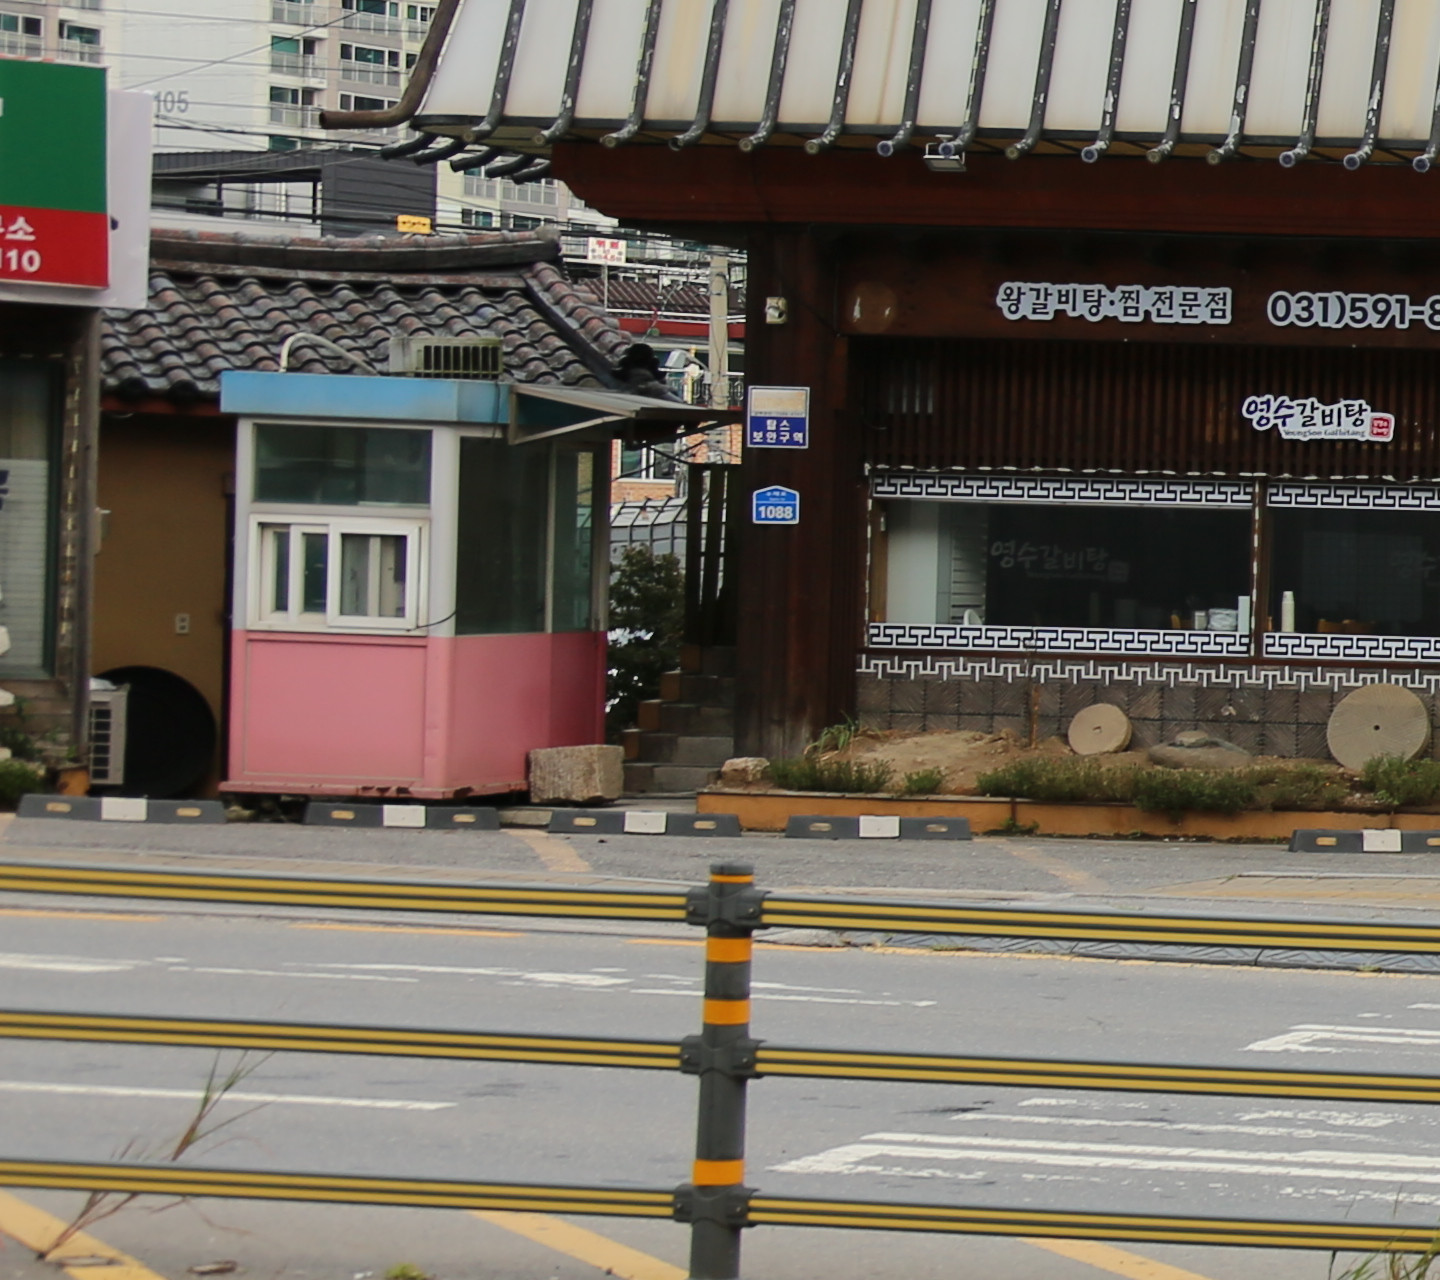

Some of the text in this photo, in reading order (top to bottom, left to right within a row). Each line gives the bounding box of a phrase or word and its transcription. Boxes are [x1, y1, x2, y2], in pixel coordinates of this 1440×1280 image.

[1151, 289, 1228, 320] 전문점
[1246, 398, 1367, 427] 영수갈비탕
[758, 505, 793, 519] 1088
